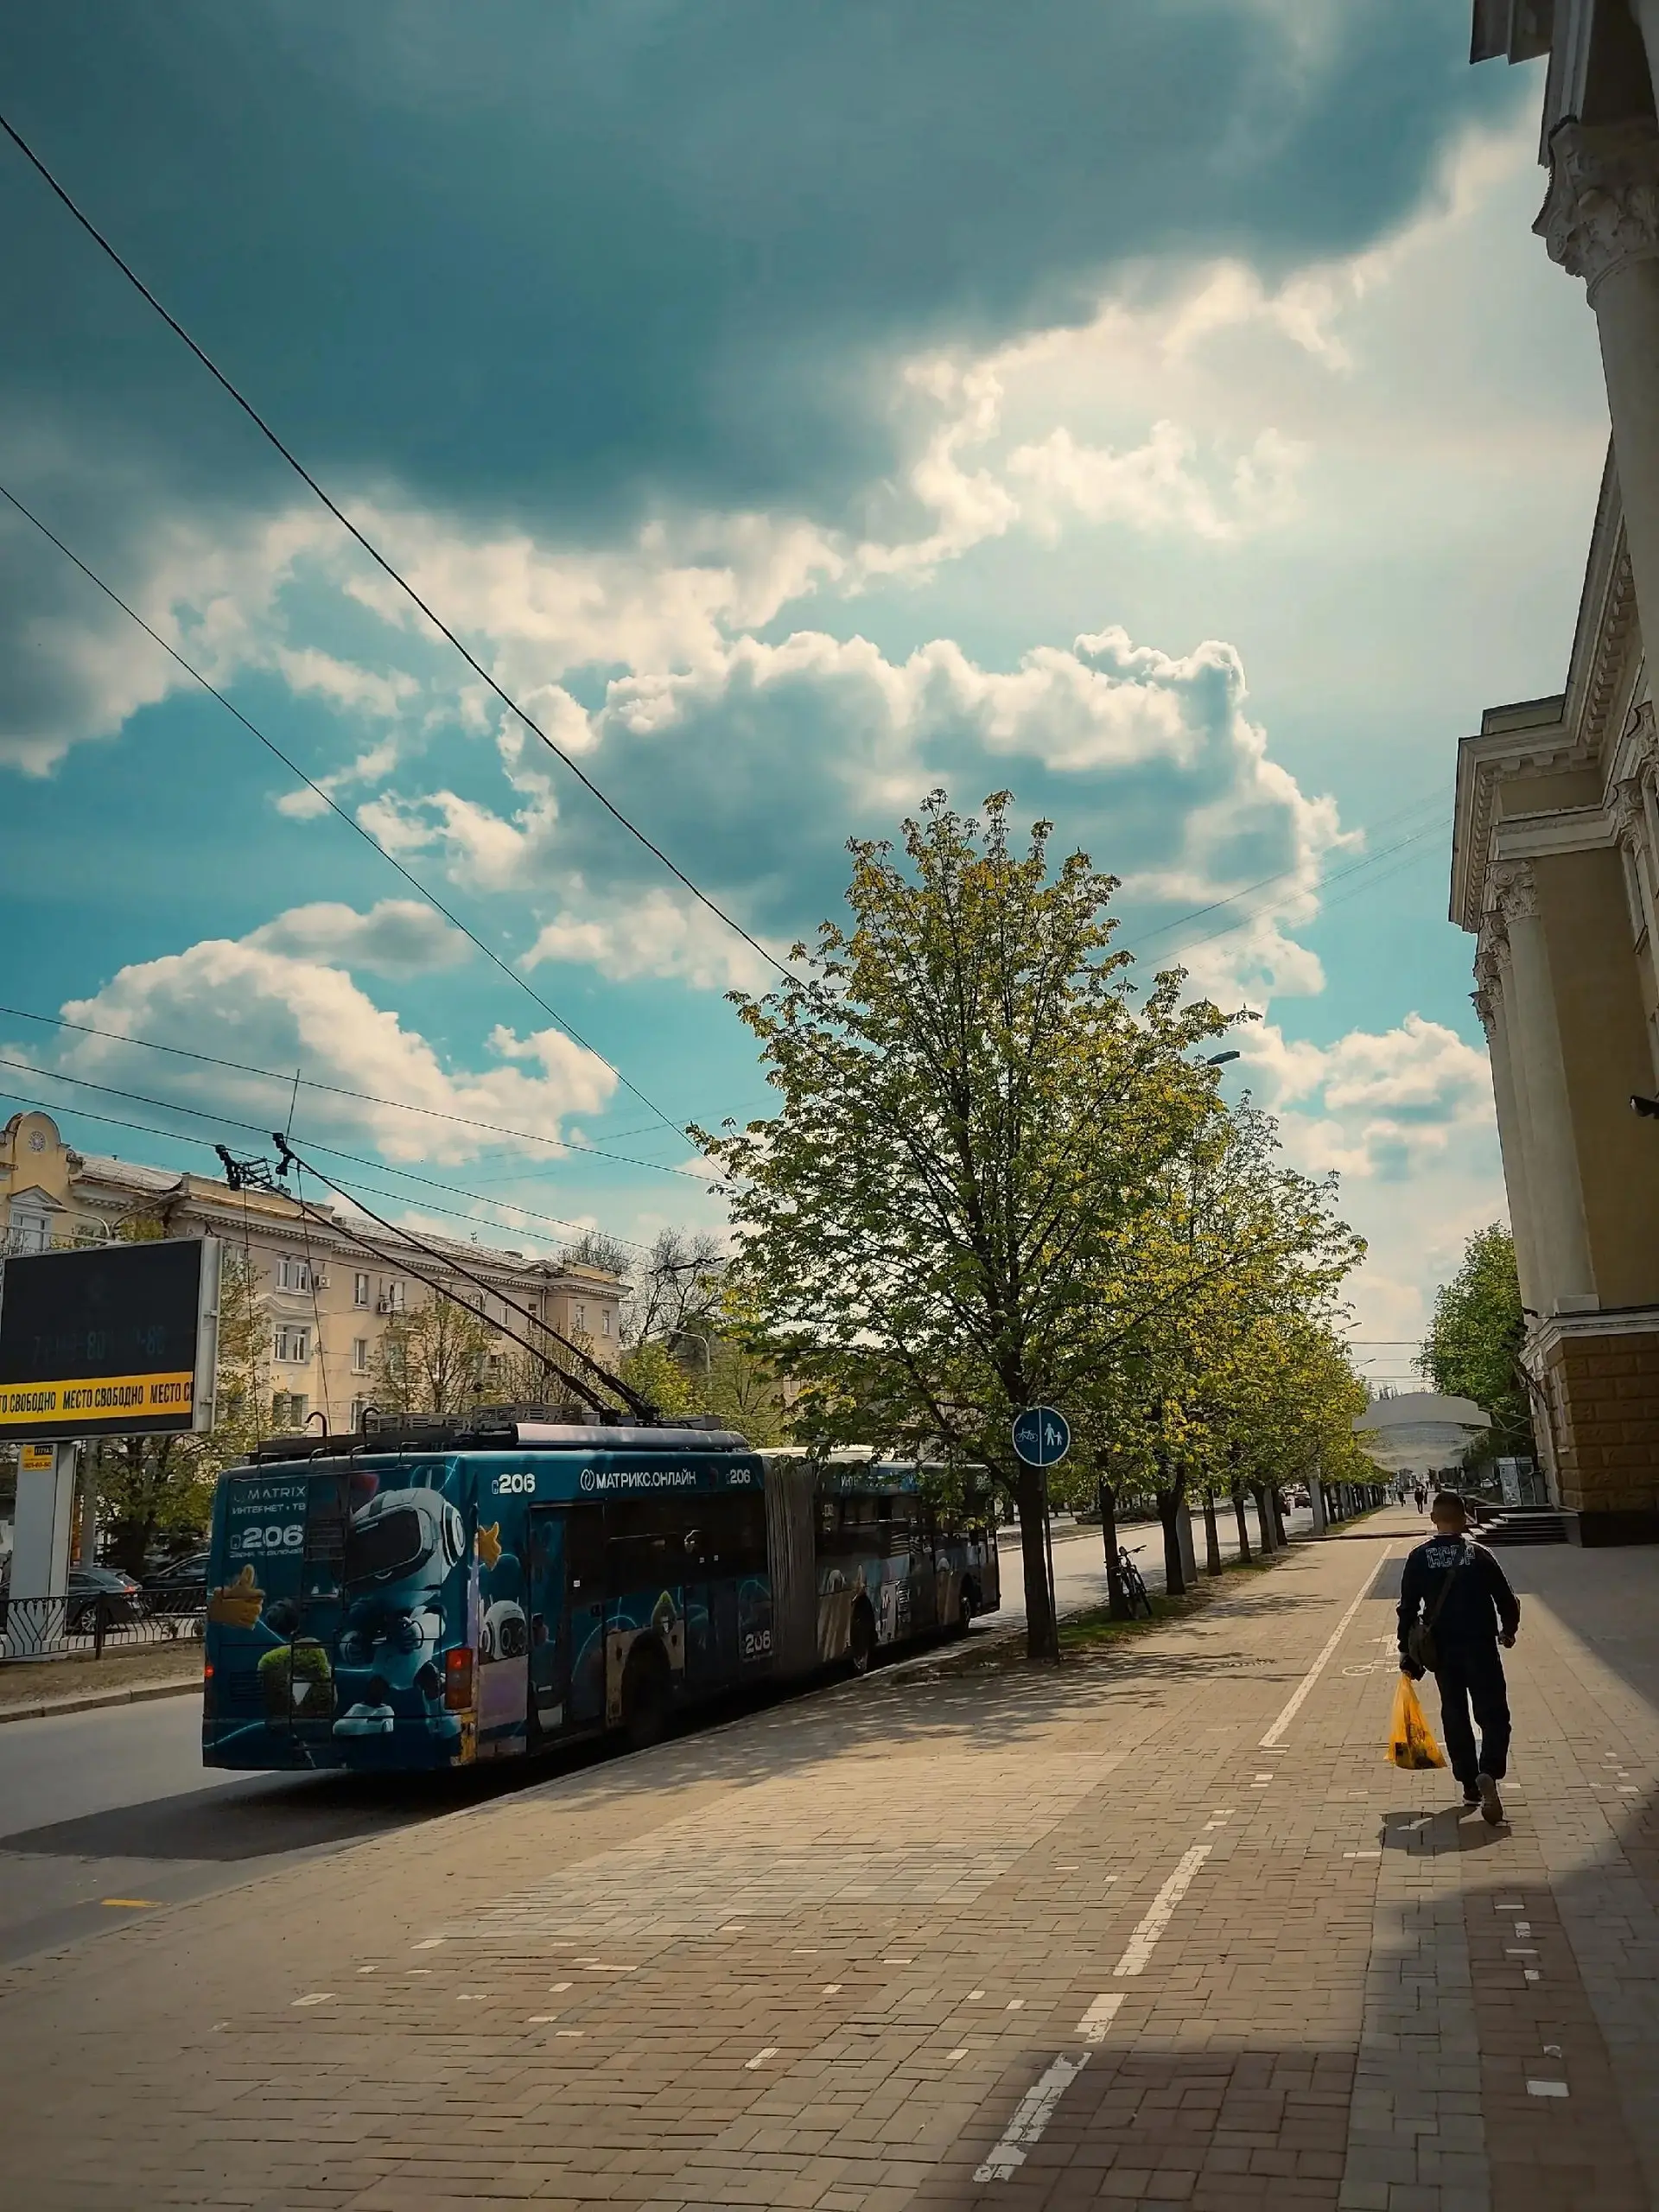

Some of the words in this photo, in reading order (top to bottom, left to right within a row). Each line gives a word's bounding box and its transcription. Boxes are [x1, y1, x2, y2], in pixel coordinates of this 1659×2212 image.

[10, 1391, 56, 1414] СВОБОДНО
[62, 1389, 92, 1410] МЕСТО
[95, 1385, 143, 1408] СВОБОДНО
[149, 1382, 181, 1404] МЕСТО
[499, 1472, 536, 1494] 206
[596, 1469, 696, 1489] МАТРИКС.ОНЛАЙН
[730, 1469, 751, 1484] 206
[247, 1486, 306, 1500] MATRIX
[293, 1502, 307, 1511] ТВ
[242, 1524, 304, 1548] 206
[746, 1630, 771, 1654] 206
